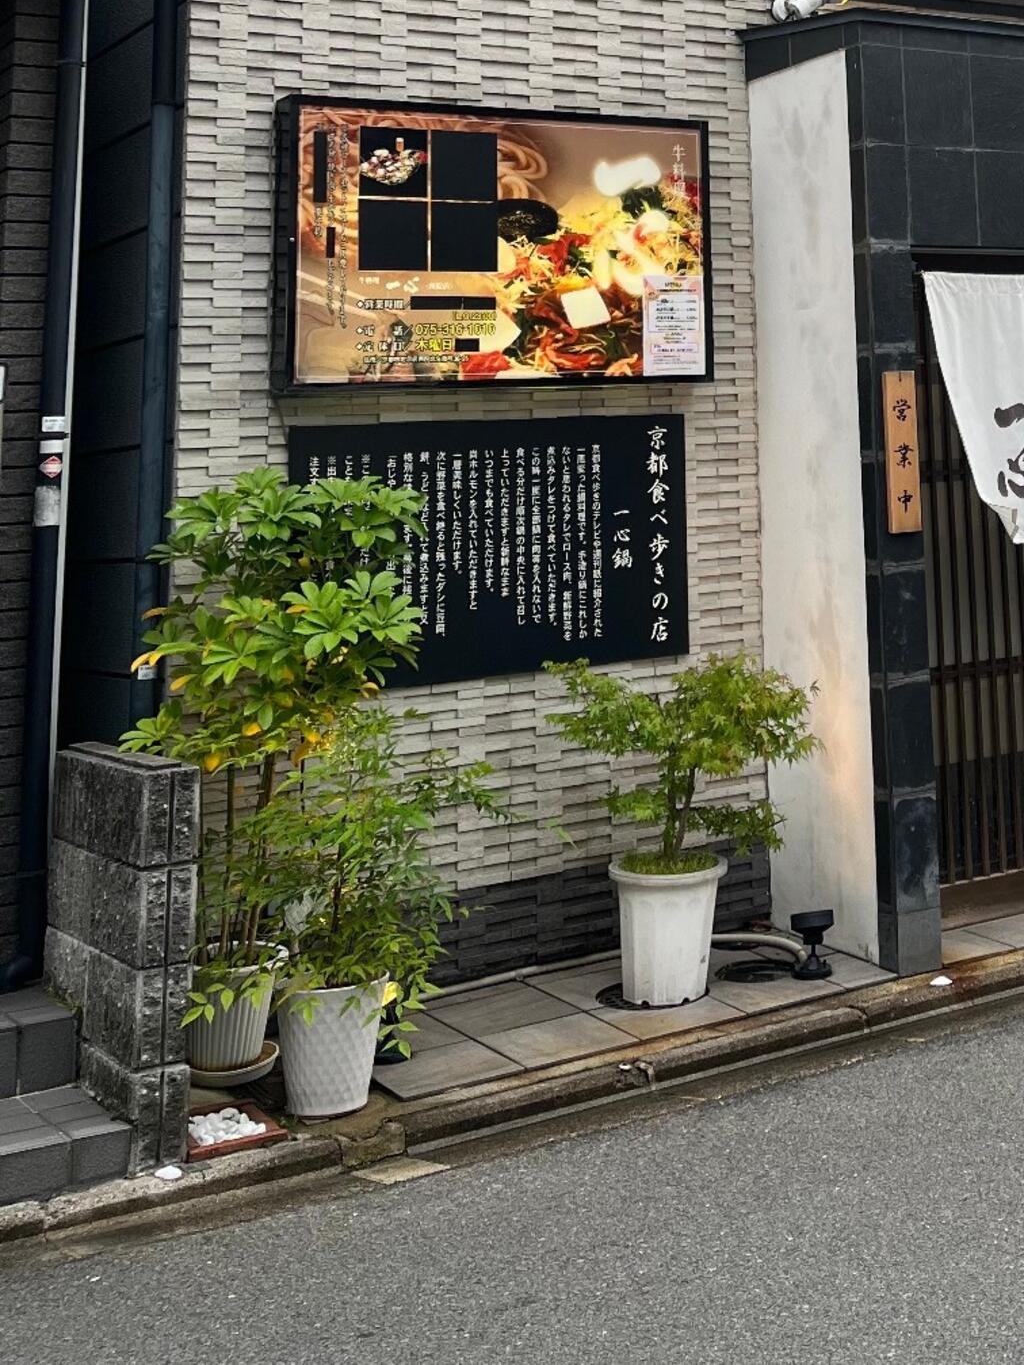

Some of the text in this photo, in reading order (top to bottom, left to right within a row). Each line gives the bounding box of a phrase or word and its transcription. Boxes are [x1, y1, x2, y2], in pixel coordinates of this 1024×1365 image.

[892, 399, 914, 515] 営業中
[612, 507, 634, 570] 一心鍋
[646, 425, 669, 643] 京都食べ歩きの店
